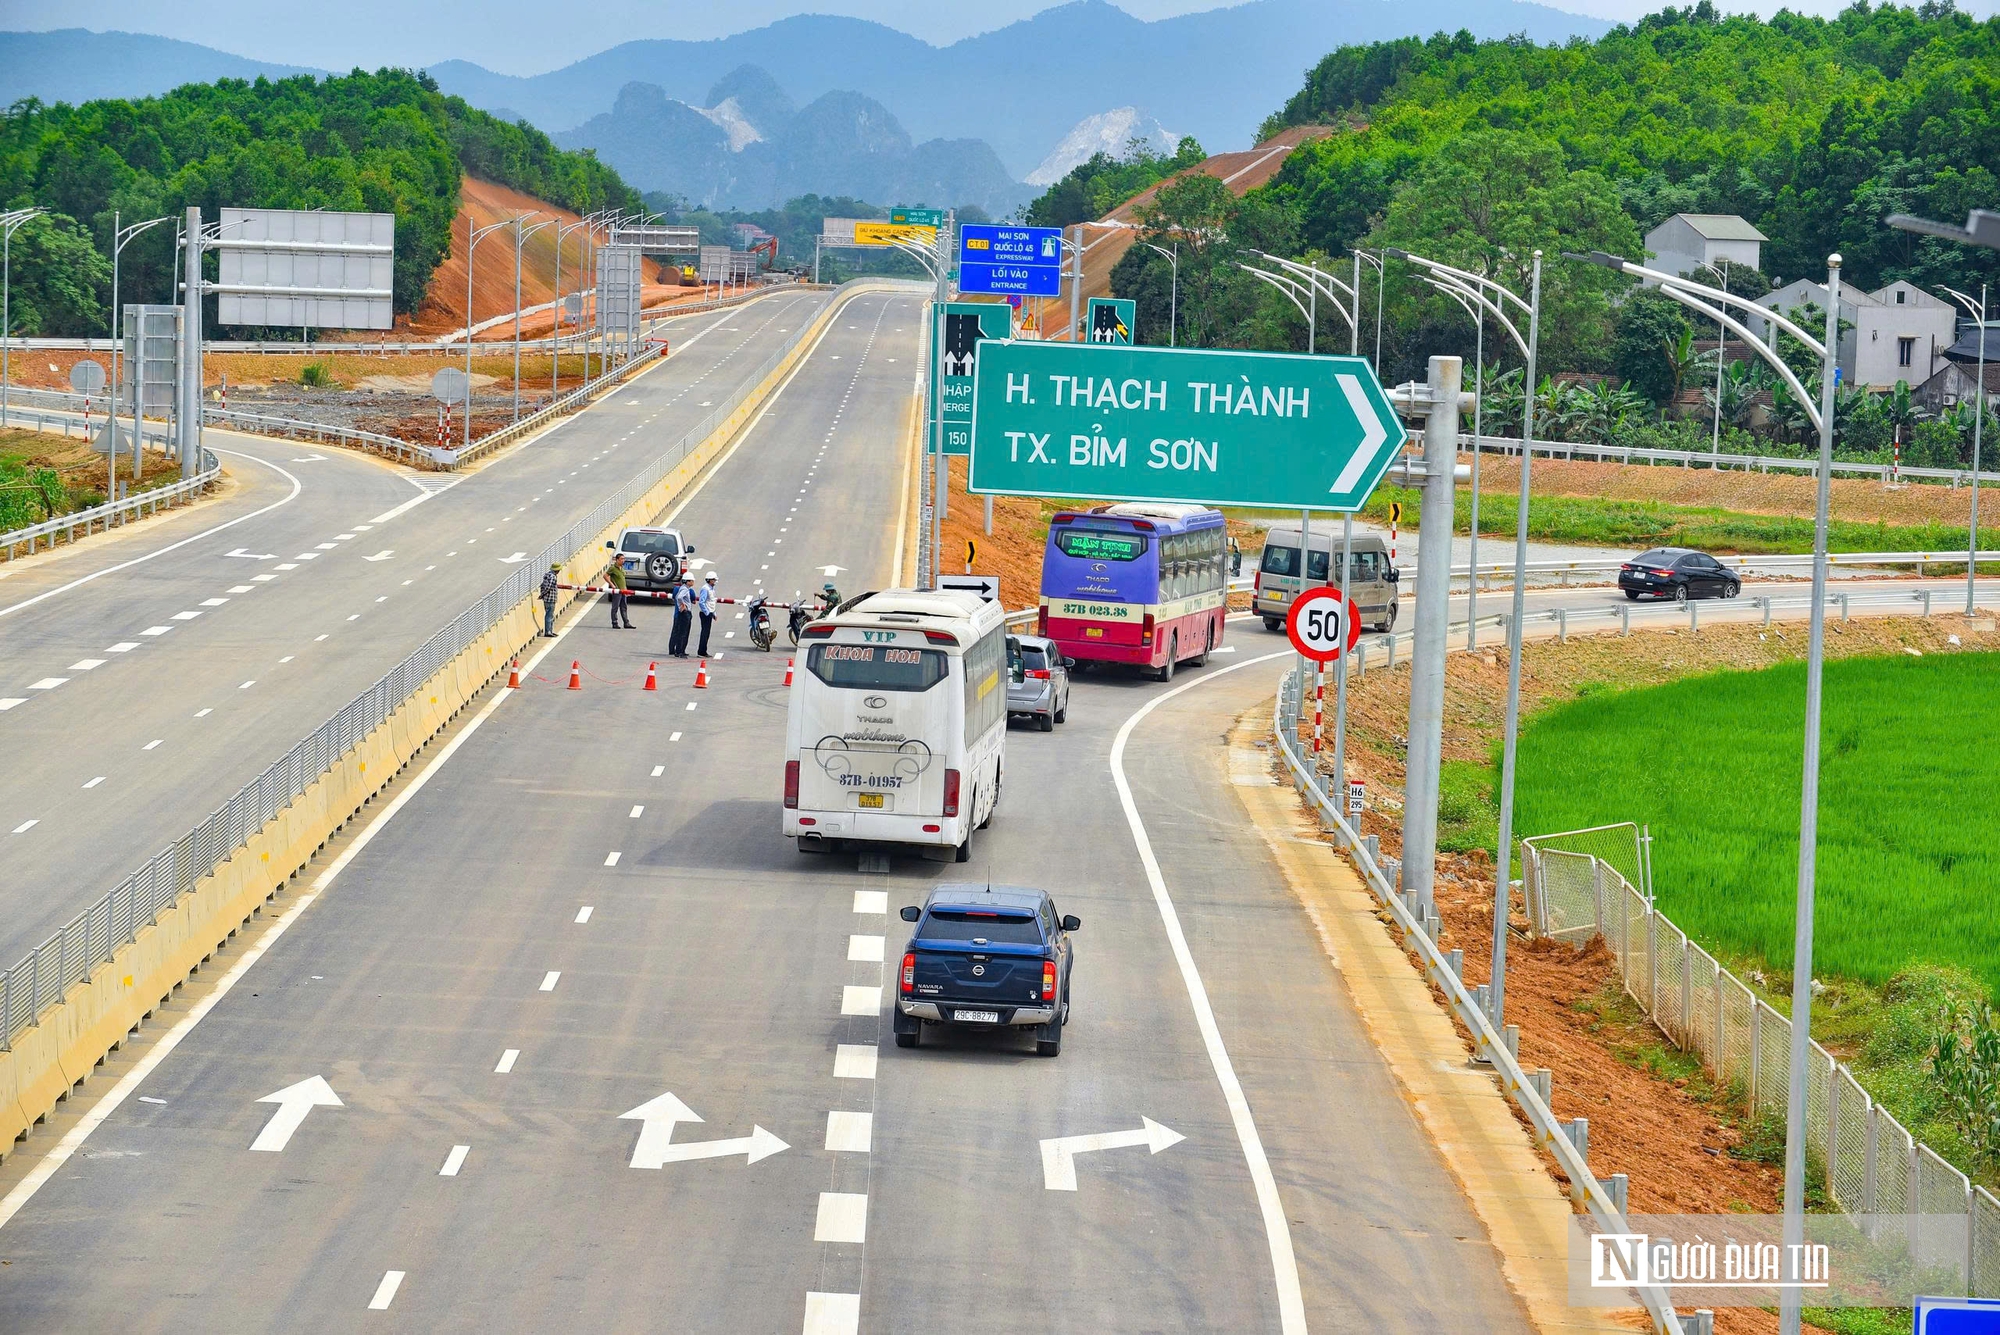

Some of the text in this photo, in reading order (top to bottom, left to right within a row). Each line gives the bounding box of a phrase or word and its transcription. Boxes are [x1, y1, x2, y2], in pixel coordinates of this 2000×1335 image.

[1014, 232, 1029, 240] SƠN
[994, 241, 1013, 252] QUỐC
[1014, 244, 1023, 253] LỘ
[992, 266, 1028, 278] LỐI VÀO
[1006, 373, 1310, 418] H. THẠCH THÀNH
[948, 432, 967, 445] 150
[1004, 424, 1219, 472] TX. BỈM SƠN
[1064, 604, 1128, 617] 37B 023.38
[1308, 610, 1339, 642] 50
[862, 631, 896, 642] VIP
[825, 645, 921, 664] KHOA HOA
[843, 727, 906, 742] mobihome
[1351, 787, 1362, 796] H6
[1351, 800, 1362, 808] 295
